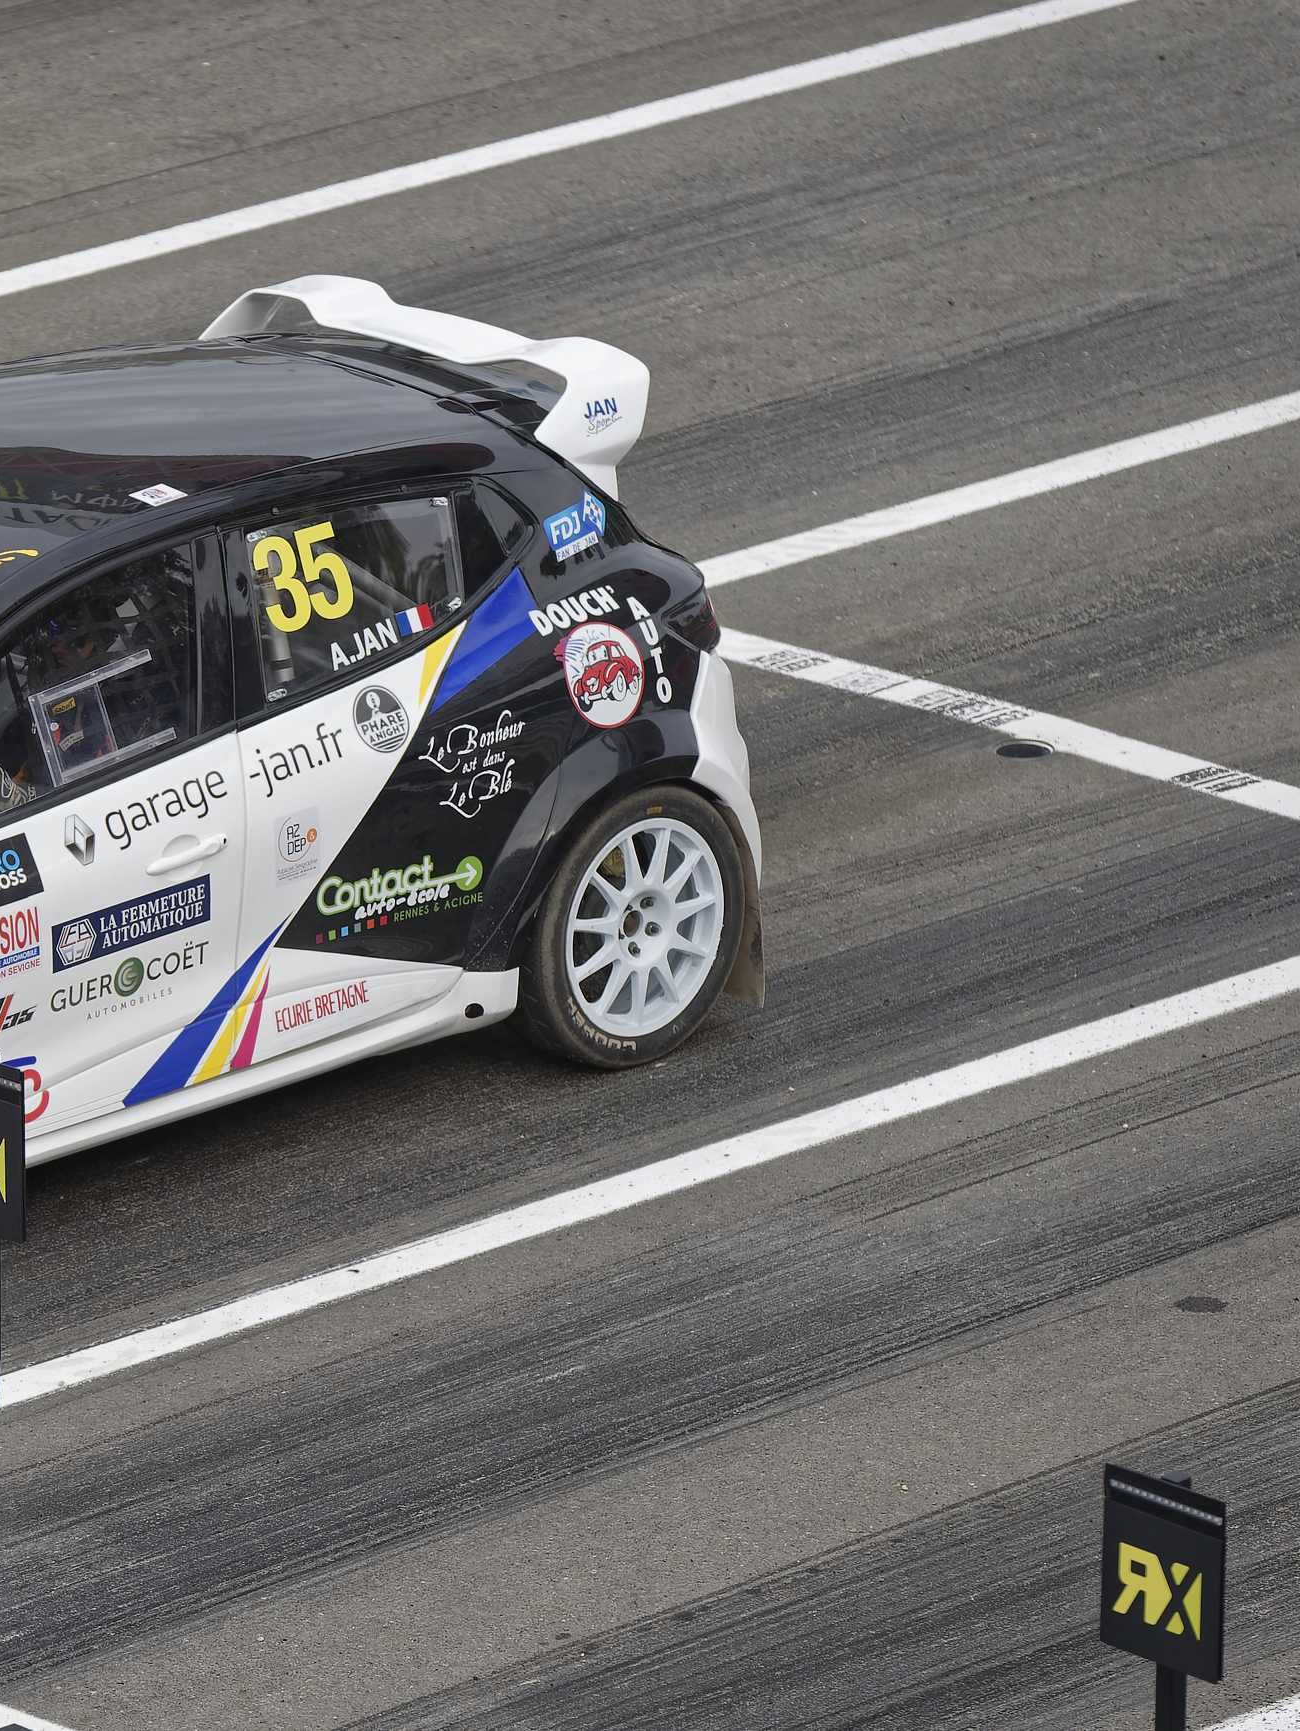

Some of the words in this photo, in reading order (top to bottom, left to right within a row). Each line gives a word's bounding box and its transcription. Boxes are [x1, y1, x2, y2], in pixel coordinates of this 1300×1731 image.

[584, 397, 618, 419] JAN
[551, 510, 581, 545] FDJ
[252, 521, 355, 634] 35
[528, 585, 620, 638] DOUCH'
[329, 617, 399, 672] A.JAN
[626, 596, 673, 704] AUTO
[361, 711, 405, 735] PHARE
[376, 723, 406, 740] NIGHT
[418, 736, 461, 773] Le
[447, 709, 526, 755] Bonheur
[462, 757, 477, 774] est
[483, 749, 505, 767] dans
[106, 769, 228, 851] garage
[439, 782, 482, 818] Le
[469, 758, 515, 800] Blé
[287, 837, 307, 855] DEP
[100, 914, 118, 933] LA
[121, 884, 206, 925] FERMETURE
[317, 854, 434, 916] Contact
[393, 907, 430, 923] RENNES
[433, 903, 441, 912] &
[444, 892, 484, 911] ACIGNE
[102, 901, 204, 949] AUTOMATIQUE
[2, 949, 39, 968] AUTOMOBILE
[8, 959, 41, 976] SEVIGNE
[50, 974, 113, 1012] GUER
[146, 941, 210, 981] COËT
[86, 986, 173, 1020] AUTOMOBILES
[275, 998, 314, 1033] ECURIE
[316, 981, 370, 1020] BRETAGNE
[1112, 1541, 1203, 1641] RX
